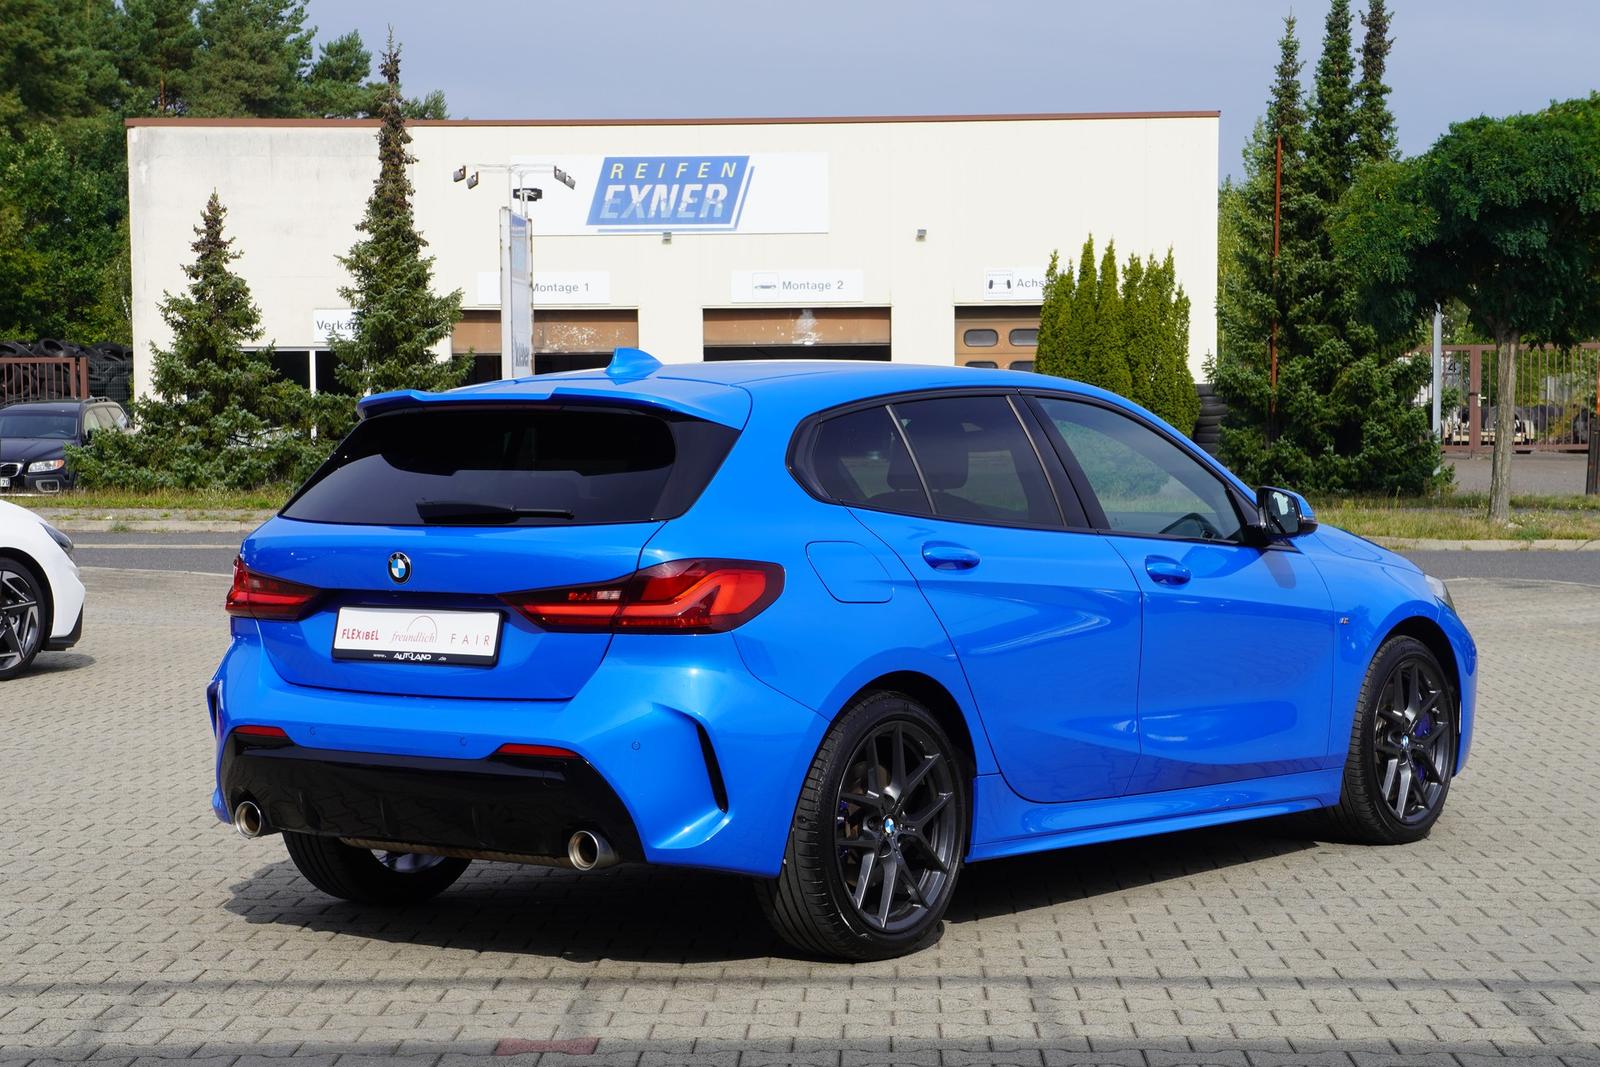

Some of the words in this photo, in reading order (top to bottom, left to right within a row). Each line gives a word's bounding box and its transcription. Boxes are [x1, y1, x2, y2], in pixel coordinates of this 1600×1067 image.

[609, 162, 737, 179] REIFEN
[599, 183, 728, 219] EXNER
[584, 283, 590, 292] 1
[782, 281, 831, 292] Montage
[837, 280, 844, 290] 2
[1016, 279, 1045, 288] Achs
[316, 320, 352, 330] Verka
[390, 631, 435, 644] freundlich
[450, 633, 490, 646] FAIR
[393, 652, 432, 661] AUTOLAND
